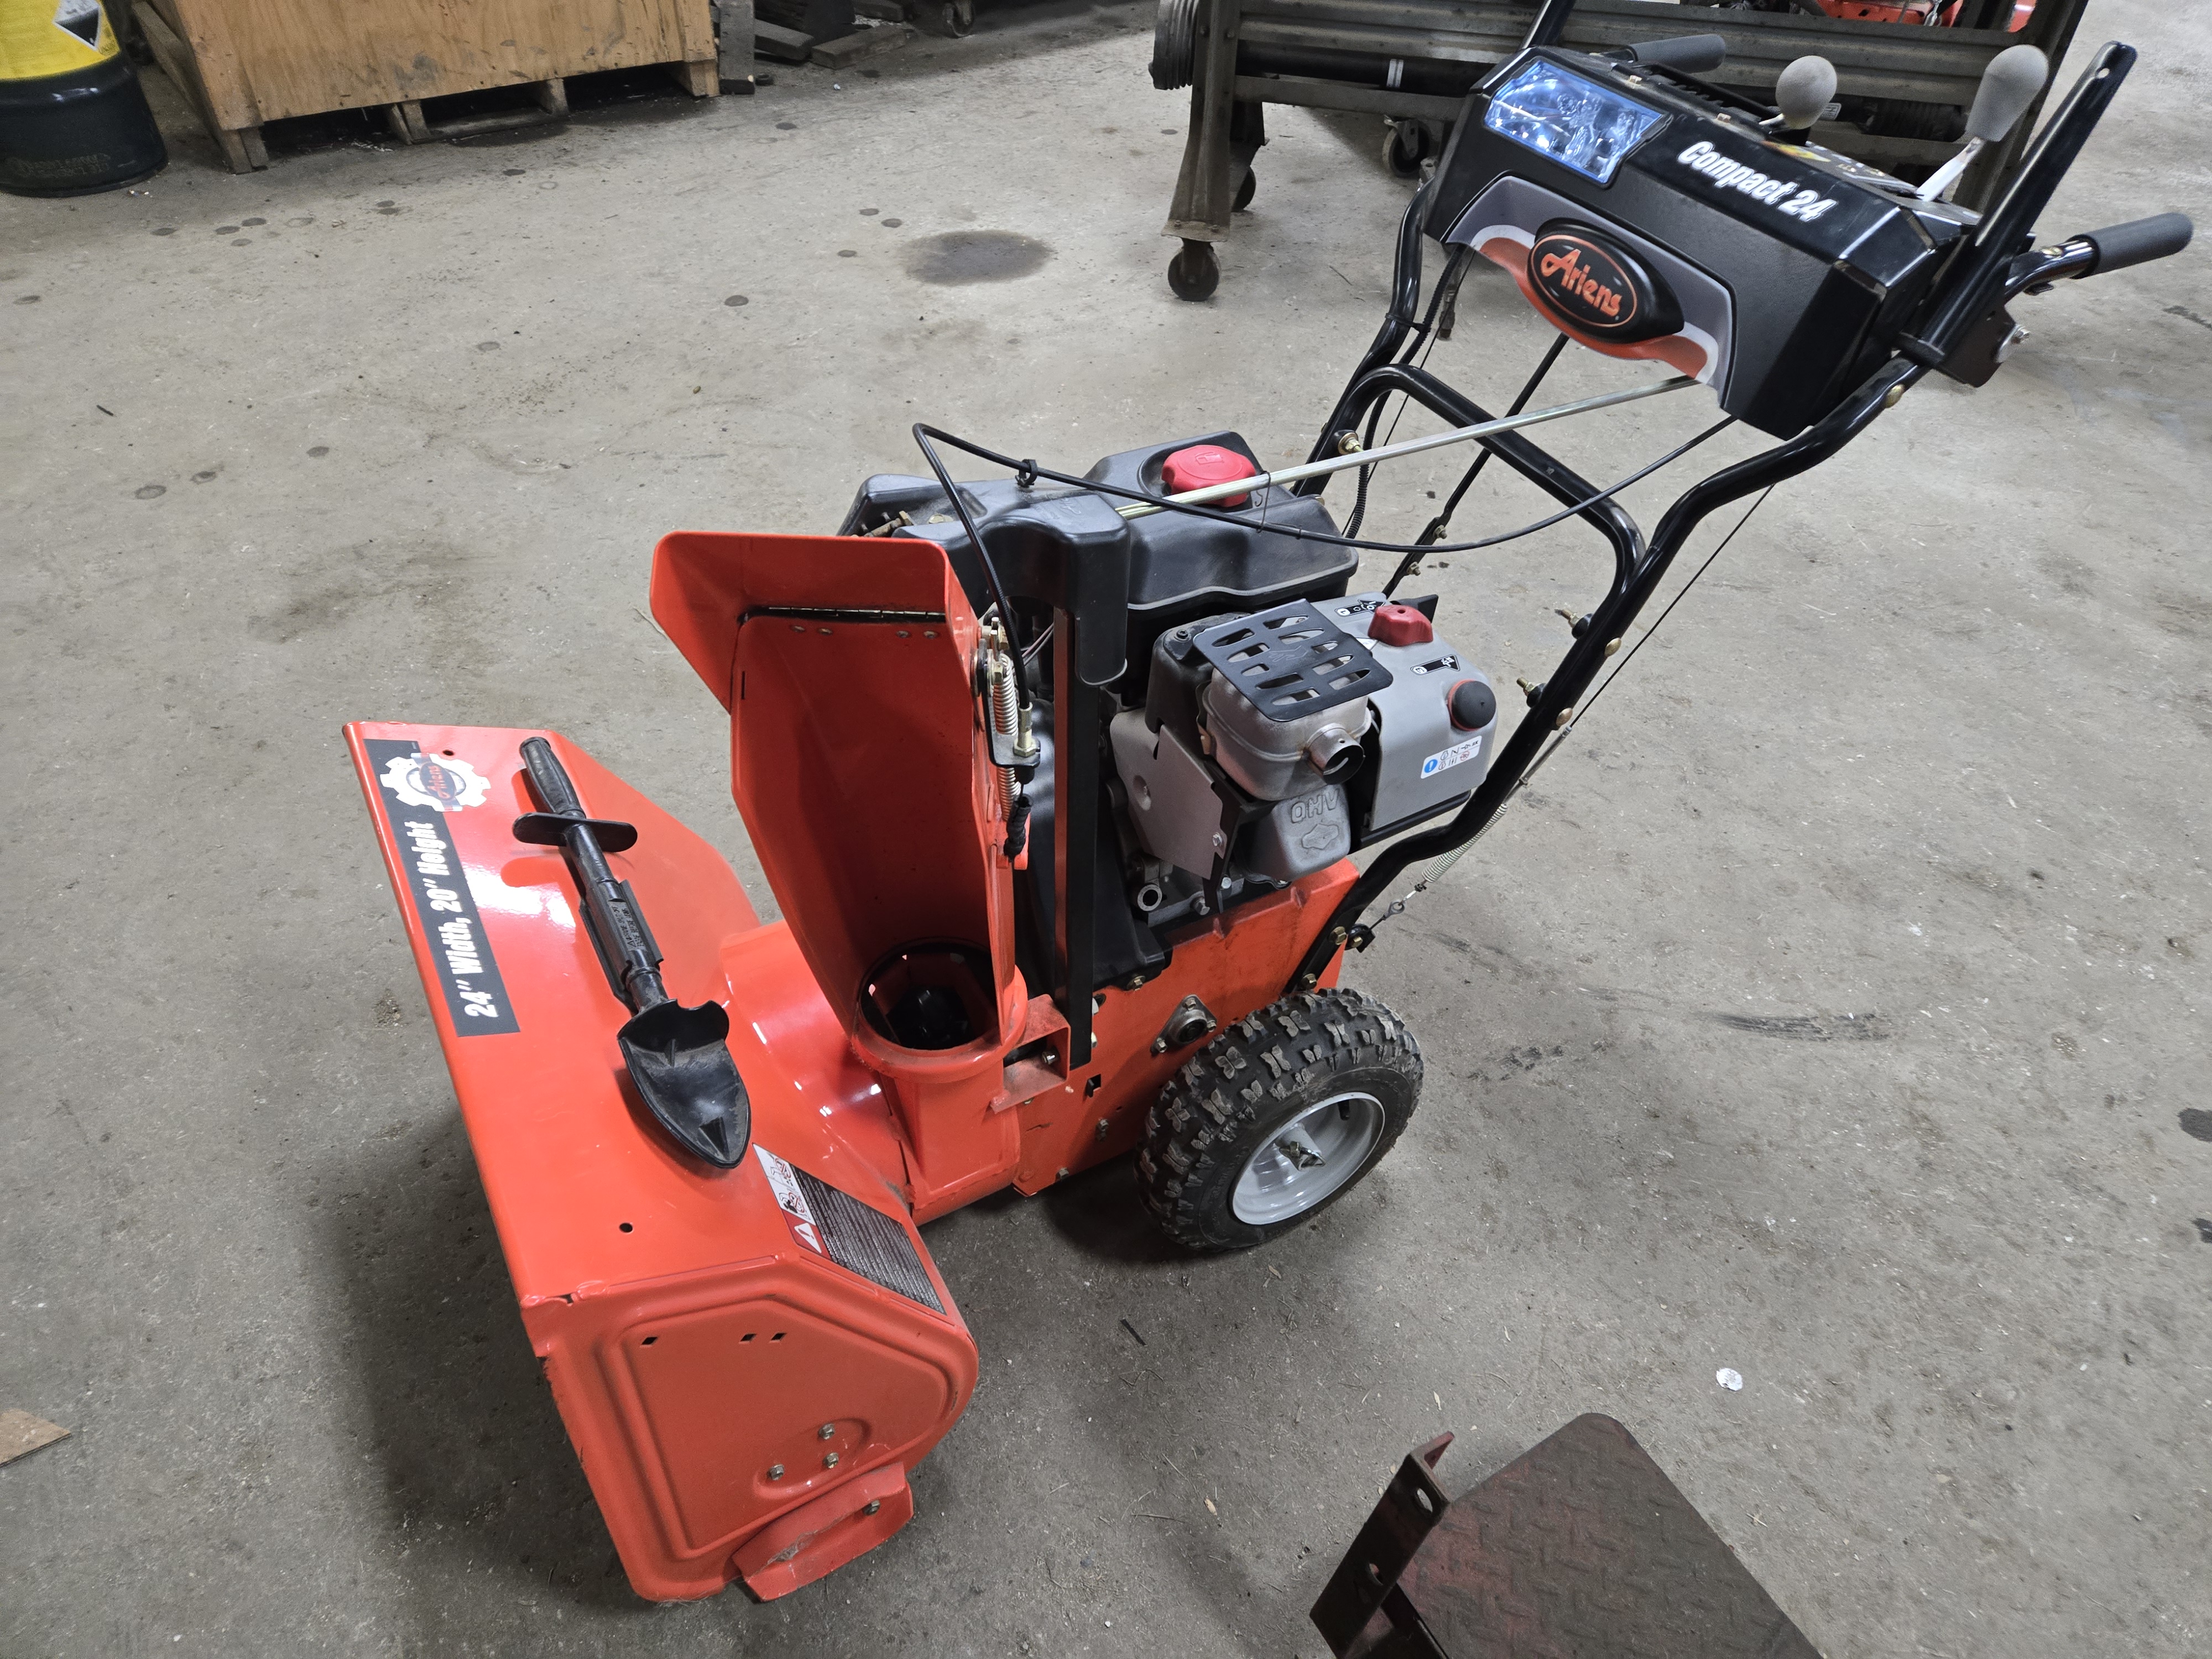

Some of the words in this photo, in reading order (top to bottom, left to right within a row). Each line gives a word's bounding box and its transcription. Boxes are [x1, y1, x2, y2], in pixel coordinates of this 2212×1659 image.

[1677, 140, 1798, 205] Compact
[1777, 189, 1838, 222] 24
[1541, 248, 1623, 317] Ariens
[1290, 787, 1340, 823] OHV
[404, 821, 450, 876] Height
[422, 878, 463, 914] 20"
[439, 917, 484, 974] Width,
[455, 979, 499, 1018] 24"
